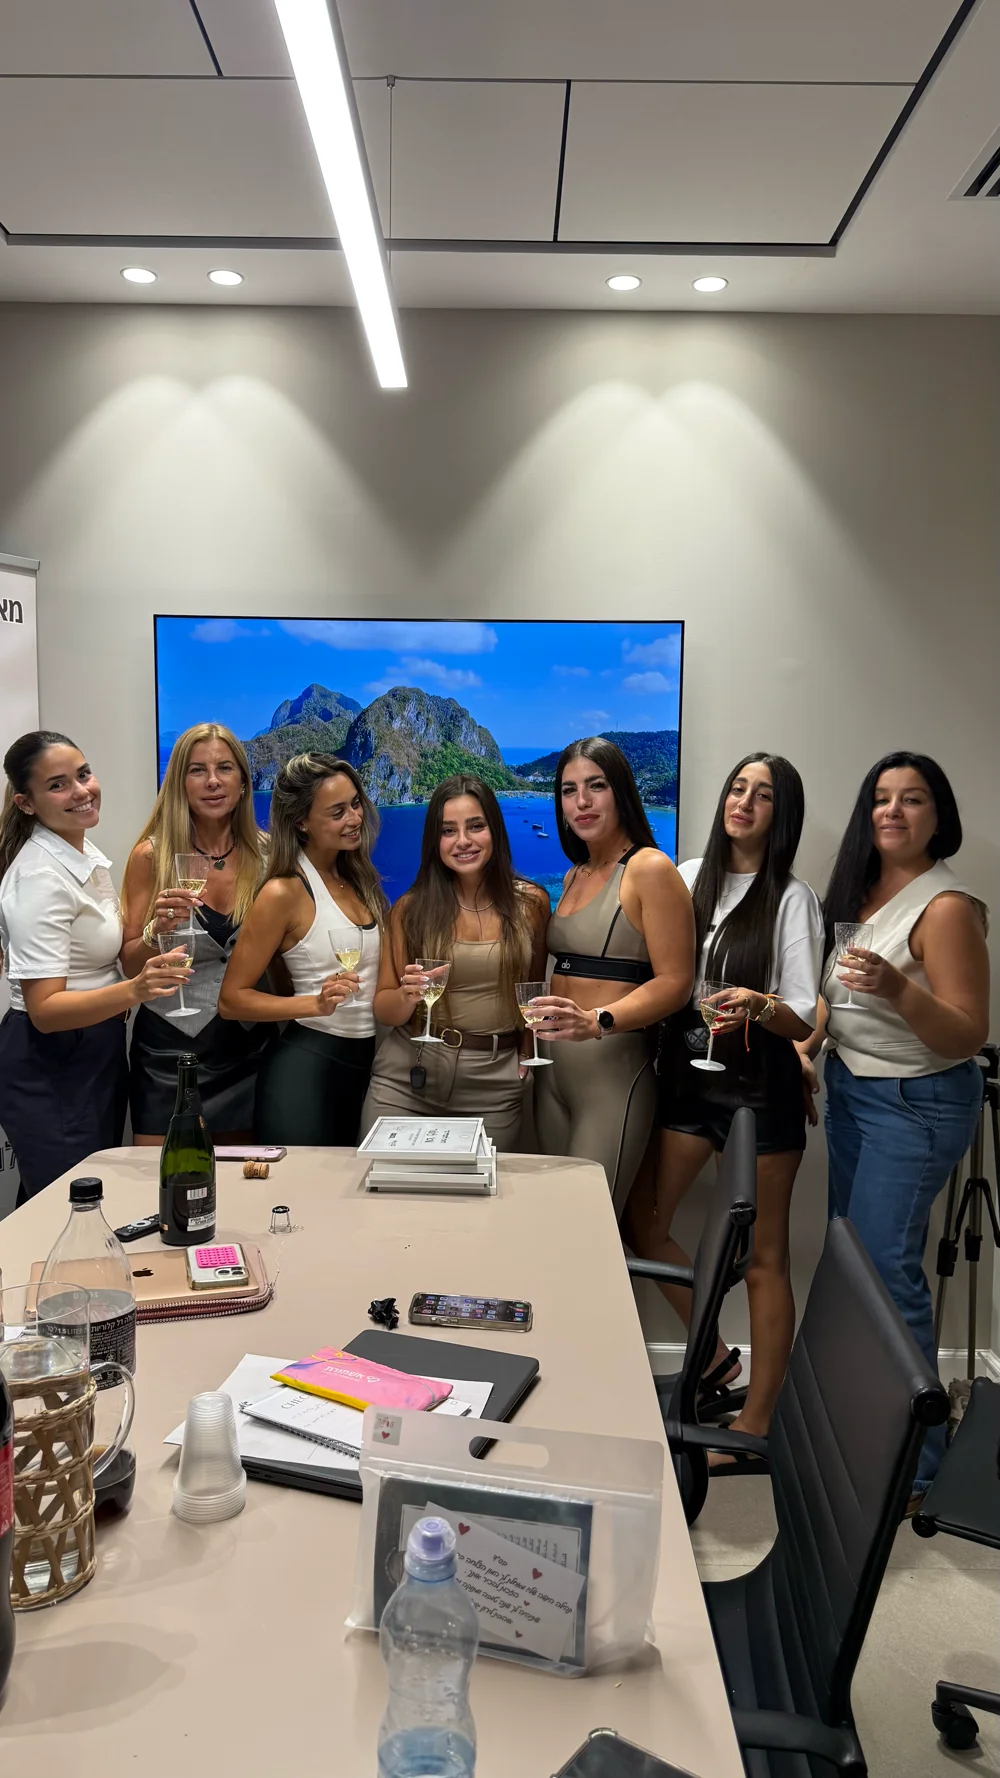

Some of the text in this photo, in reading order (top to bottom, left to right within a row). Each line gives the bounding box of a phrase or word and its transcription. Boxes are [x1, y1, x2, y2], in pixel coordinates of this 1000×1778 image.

[91, 1321, 115, 1332] קלוריות
[324, 1366, 364, 1379] אשמורת
[466, 1556, 486, 1571] הצלחה
[485, 1568, 499, 1577] המון
[483, 1577, 504, 1591] להכיר
[482, 1591, 500, 1603] טובה
[538, 1592, 554, 1604] היפה
[498, 1599, 511, 1609] שנה
